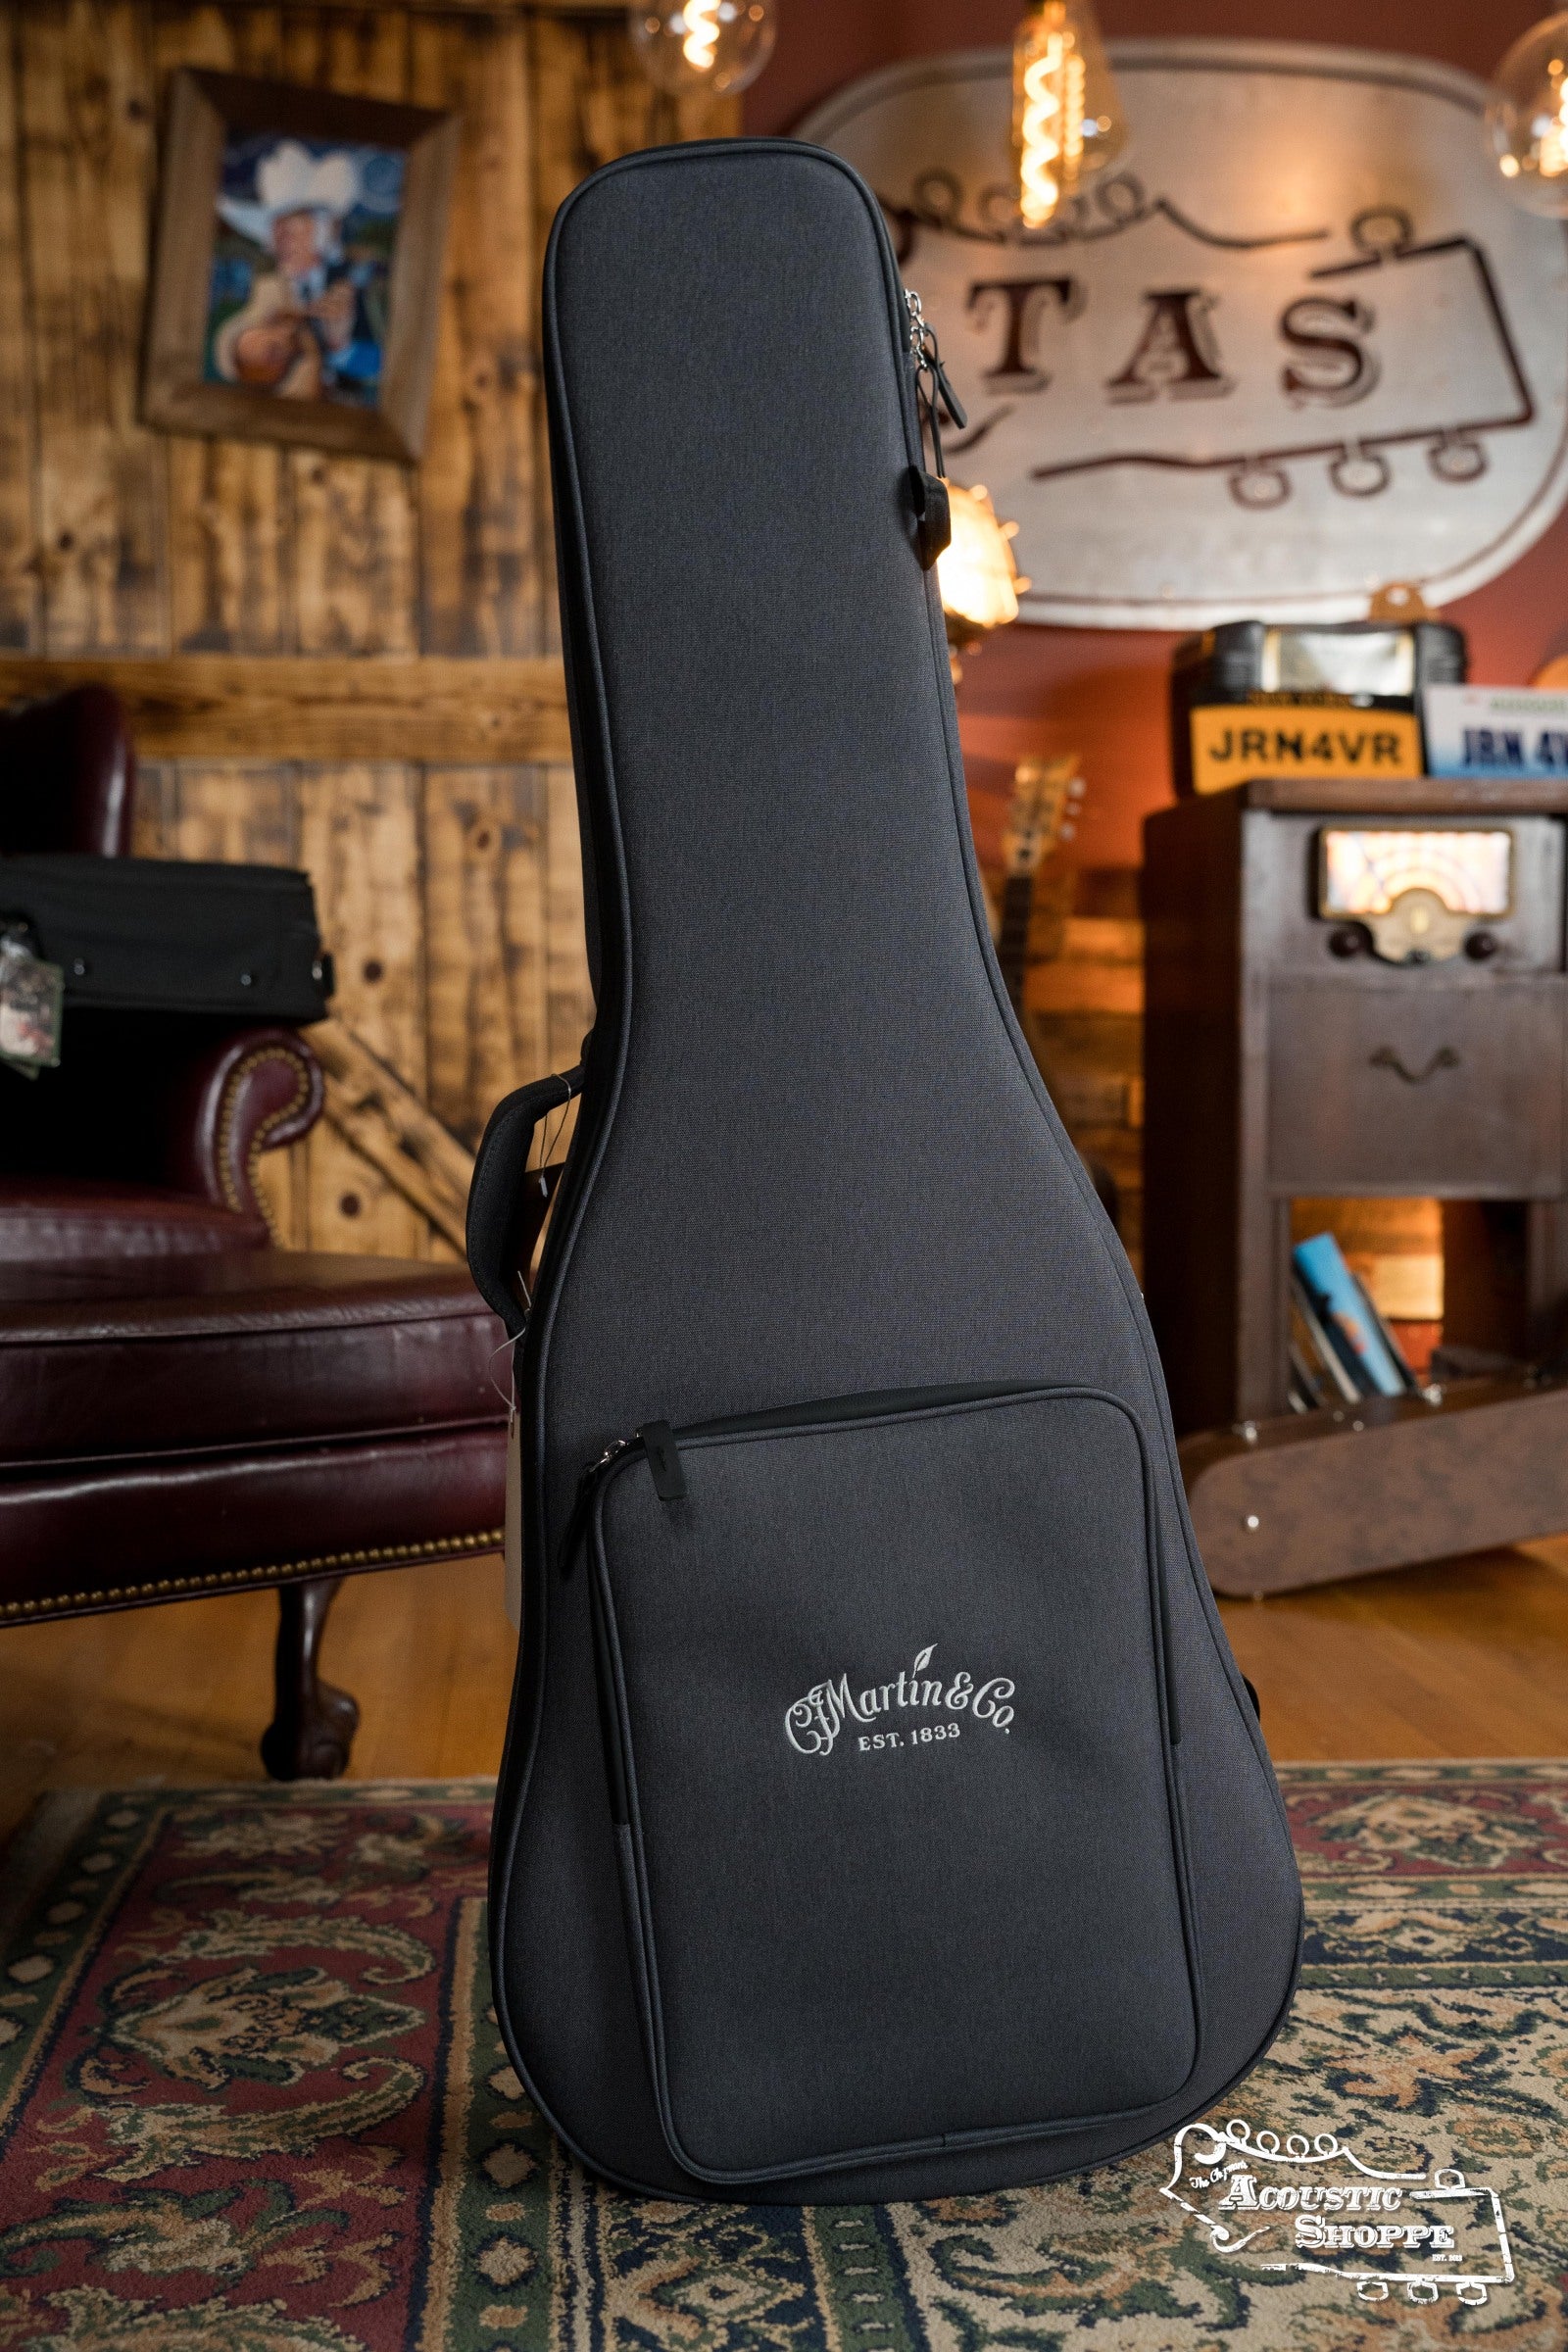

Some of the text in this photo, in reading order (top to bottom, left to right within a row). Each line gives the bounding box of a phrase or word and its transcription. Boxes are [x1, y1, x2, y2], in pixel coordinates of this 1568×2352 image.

[967, 277, 1378, 407] TAS
[1209, 728, 1401, 763] JRN4VR
[858, 1723, 960, 1751] EST. 1833
